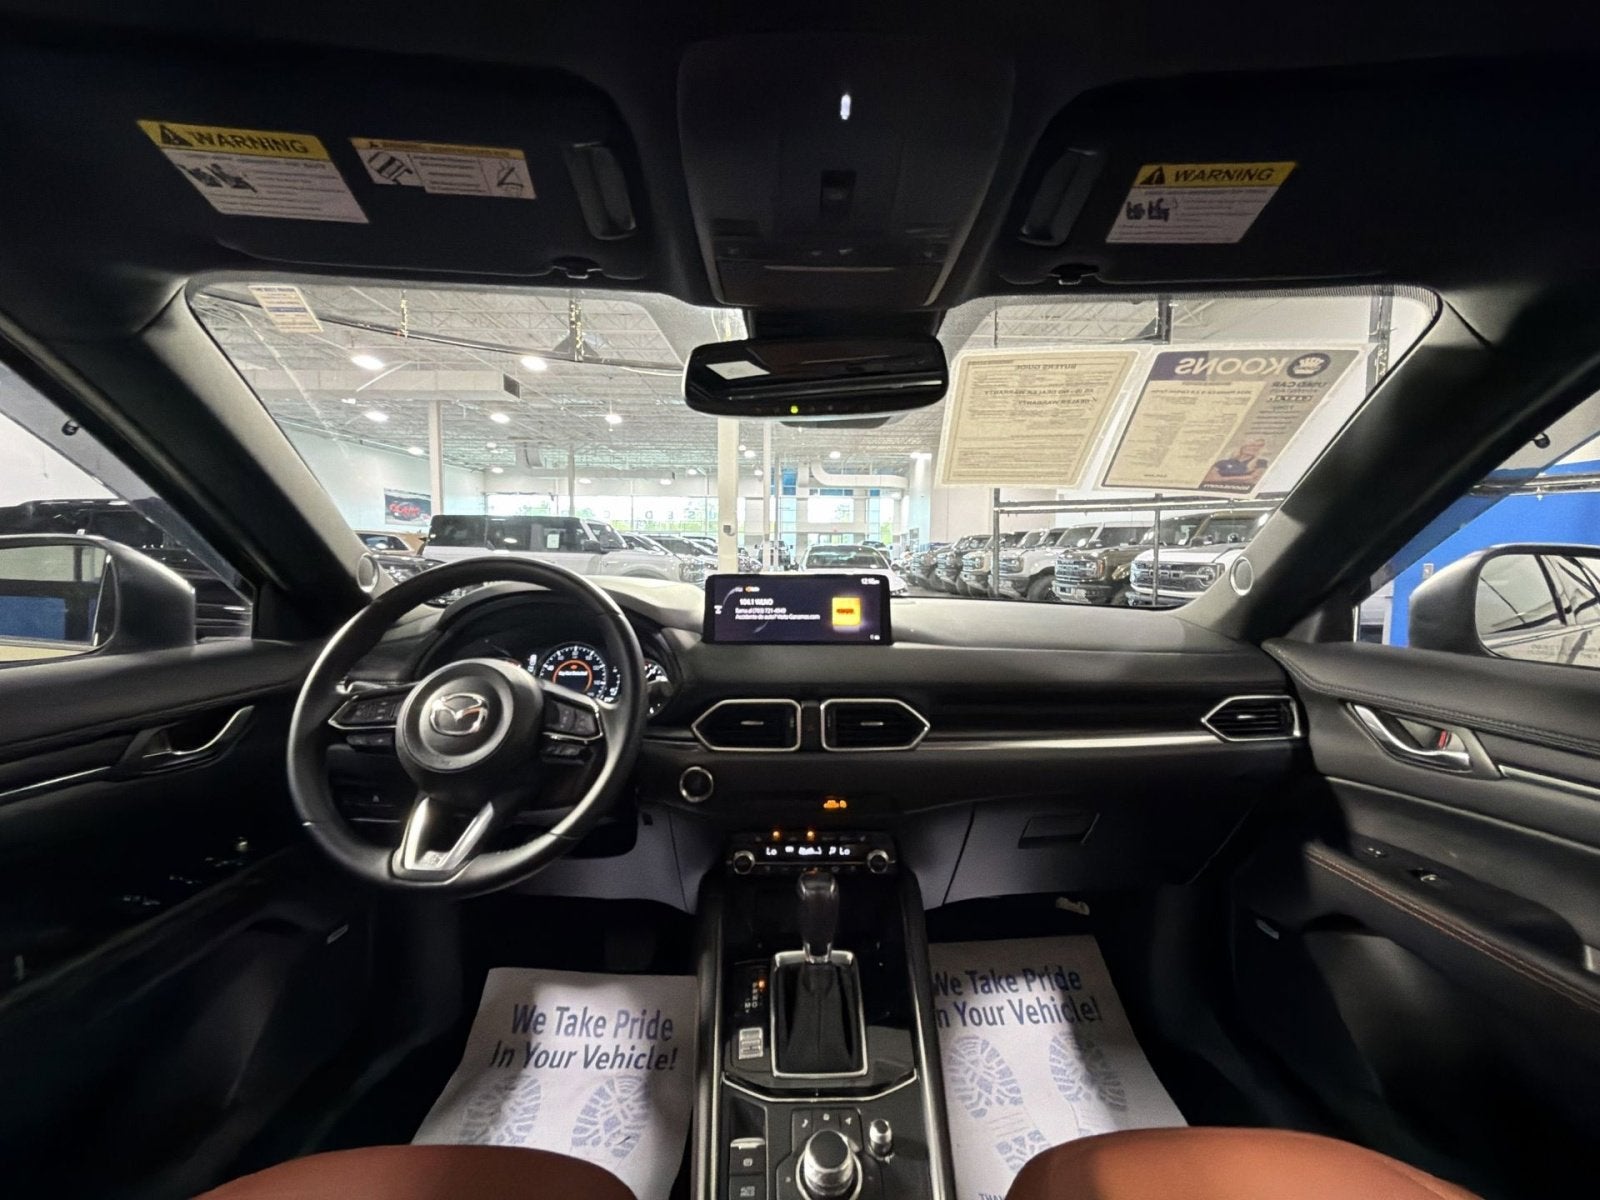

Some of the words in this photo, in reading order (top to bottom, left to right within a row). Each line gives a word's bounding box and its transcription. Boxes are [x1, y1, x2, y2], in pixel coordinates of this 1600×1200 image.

[187, 130, 310, 154] WARNING
[1173, 167, 1274, 182] WARNING
[932, 970, 965, 997] We
[965, 968, 1019, 996] Take
[1022, 965, 1082, 994] Pride
[511, 1004, 547, 1036] We
[555, 1006, 607, 1038] Take
[613, 1008, 674, 1042] Pride
[937, 1009, 949, 1028] n
[953, 1001, 1005, 1027] Your
[1009, 996, 1103, 1026] Vehicle!
[489, 1040, 514, 1067] In
[522, 1042, 577, 1070] Your
[583, 1044, 678, 1071] Vehicle!
